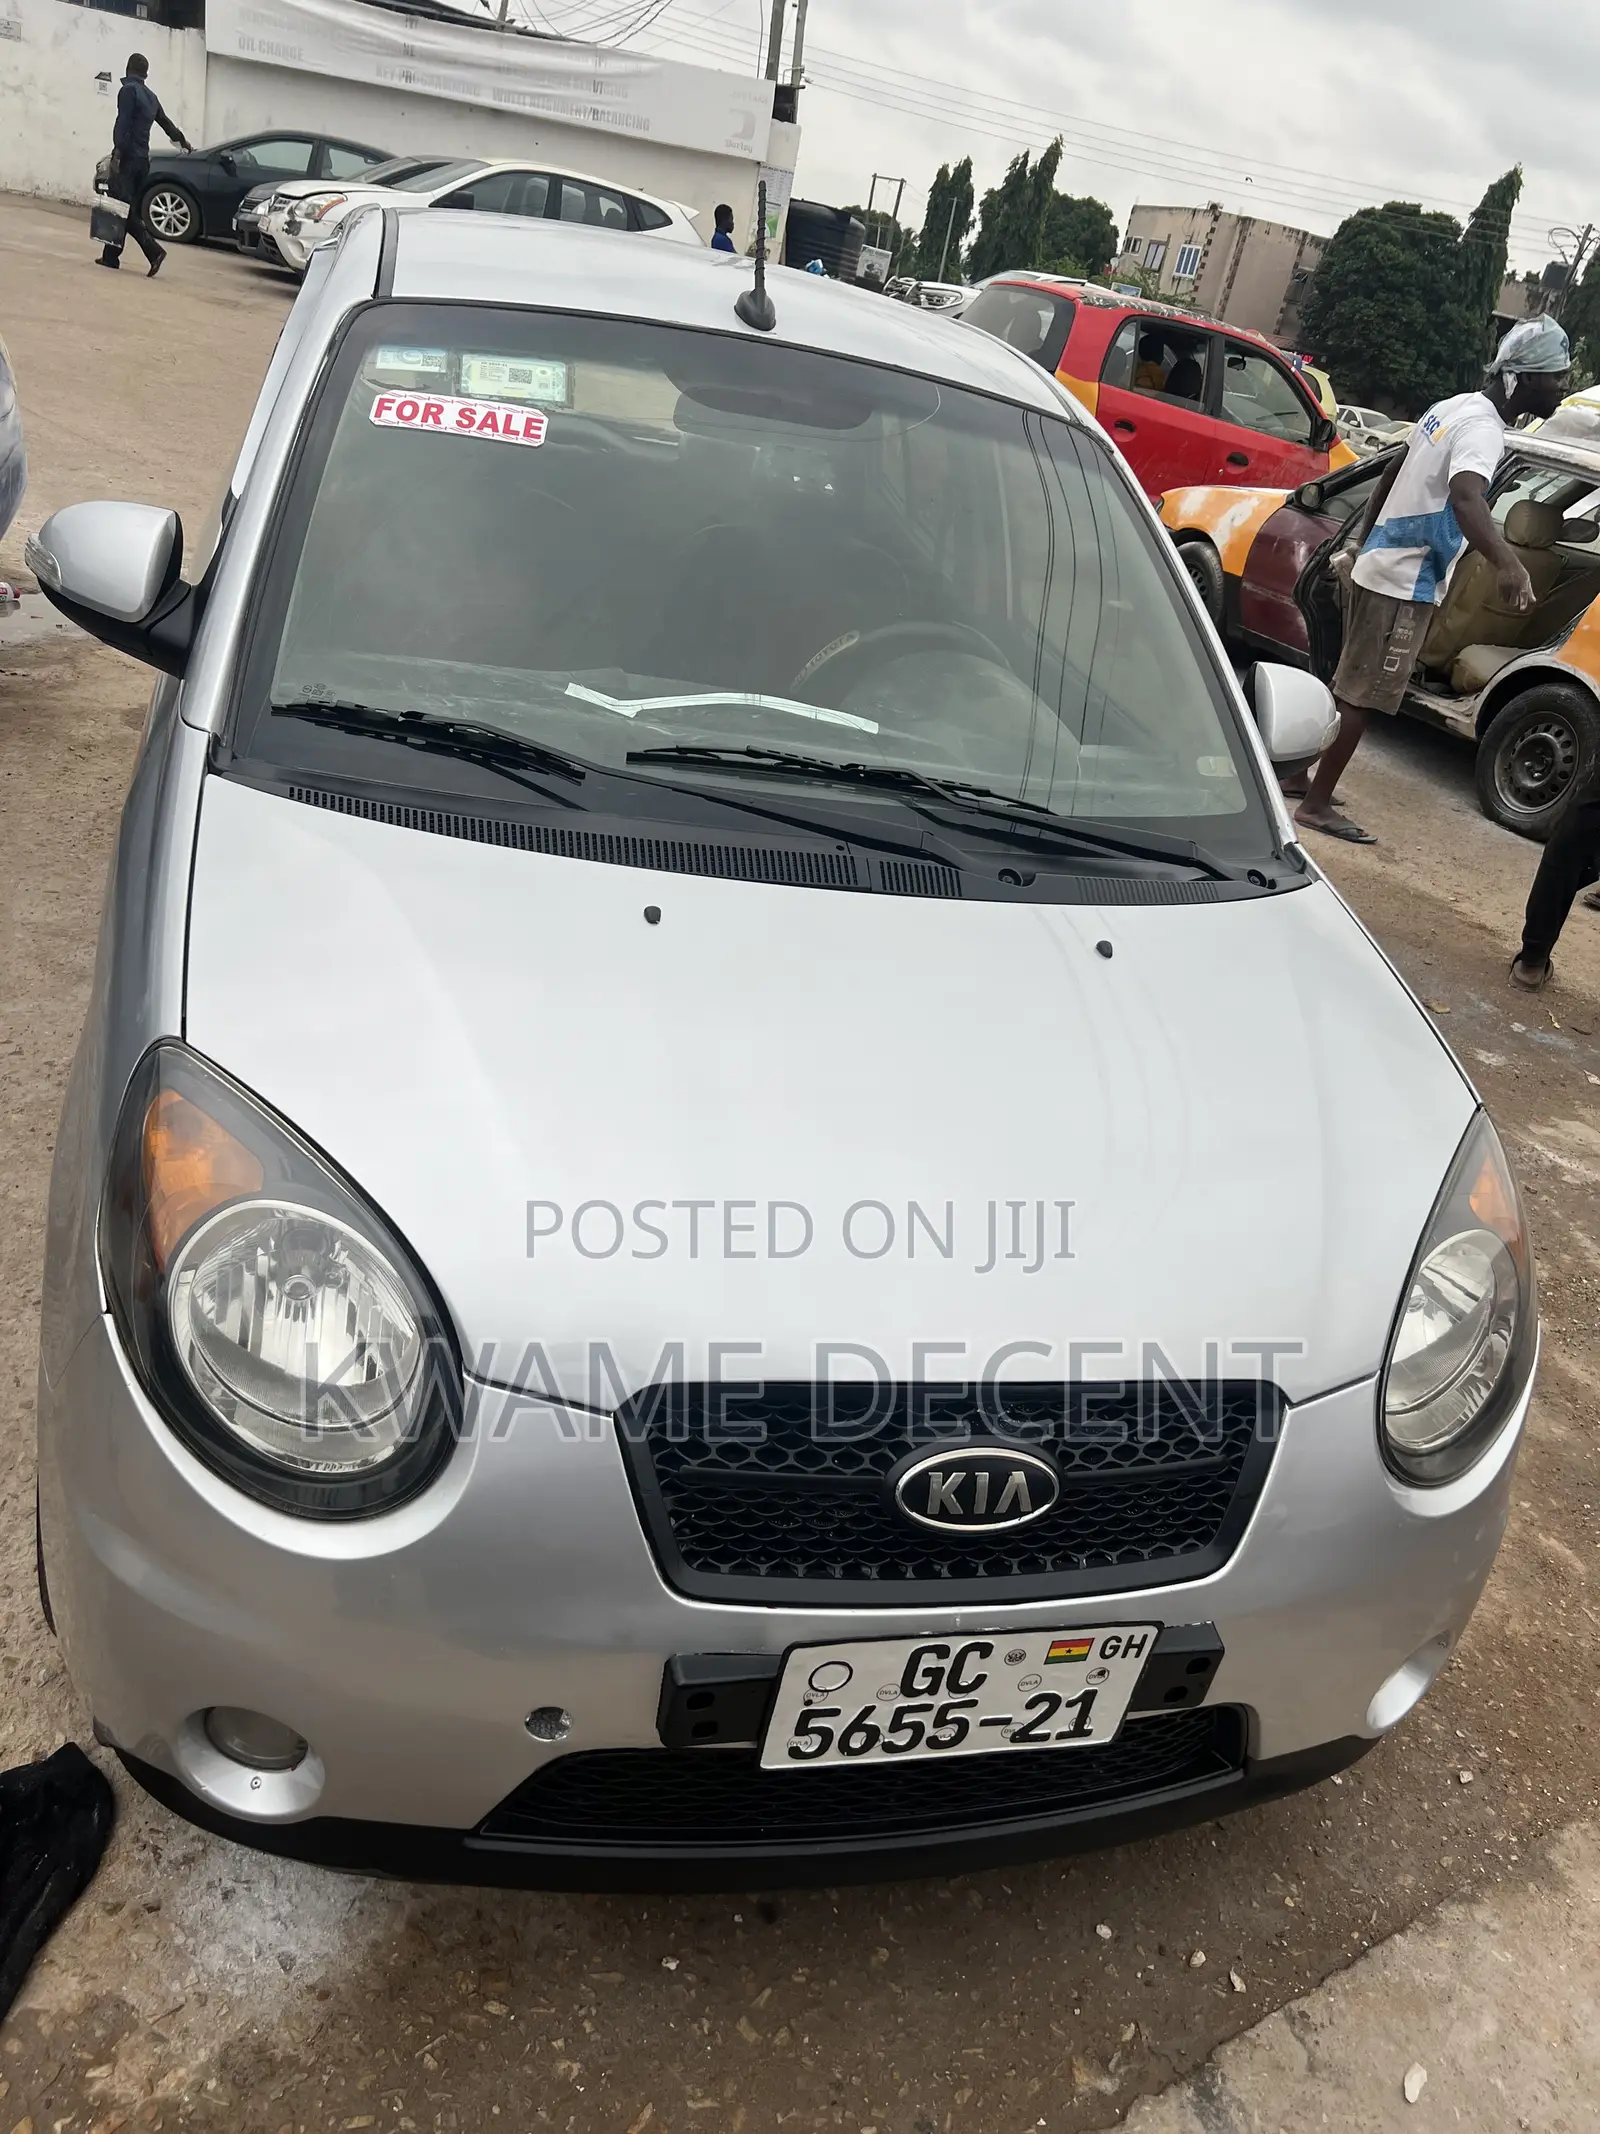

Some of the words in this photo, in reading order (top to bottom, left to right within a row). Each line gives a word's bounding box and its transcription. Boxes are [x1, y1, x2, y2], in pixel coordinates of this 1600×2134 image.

[374, 398, 444, 425] FOR
[455, 408, 544, 440] SALE
[927, 1471, 1033, 1515] KIA
[1099, 1634, 1148, 1660] GH
[900, 1641, 994, 1698] GC
[788, 1688, 1098, 1760] 5655-21
